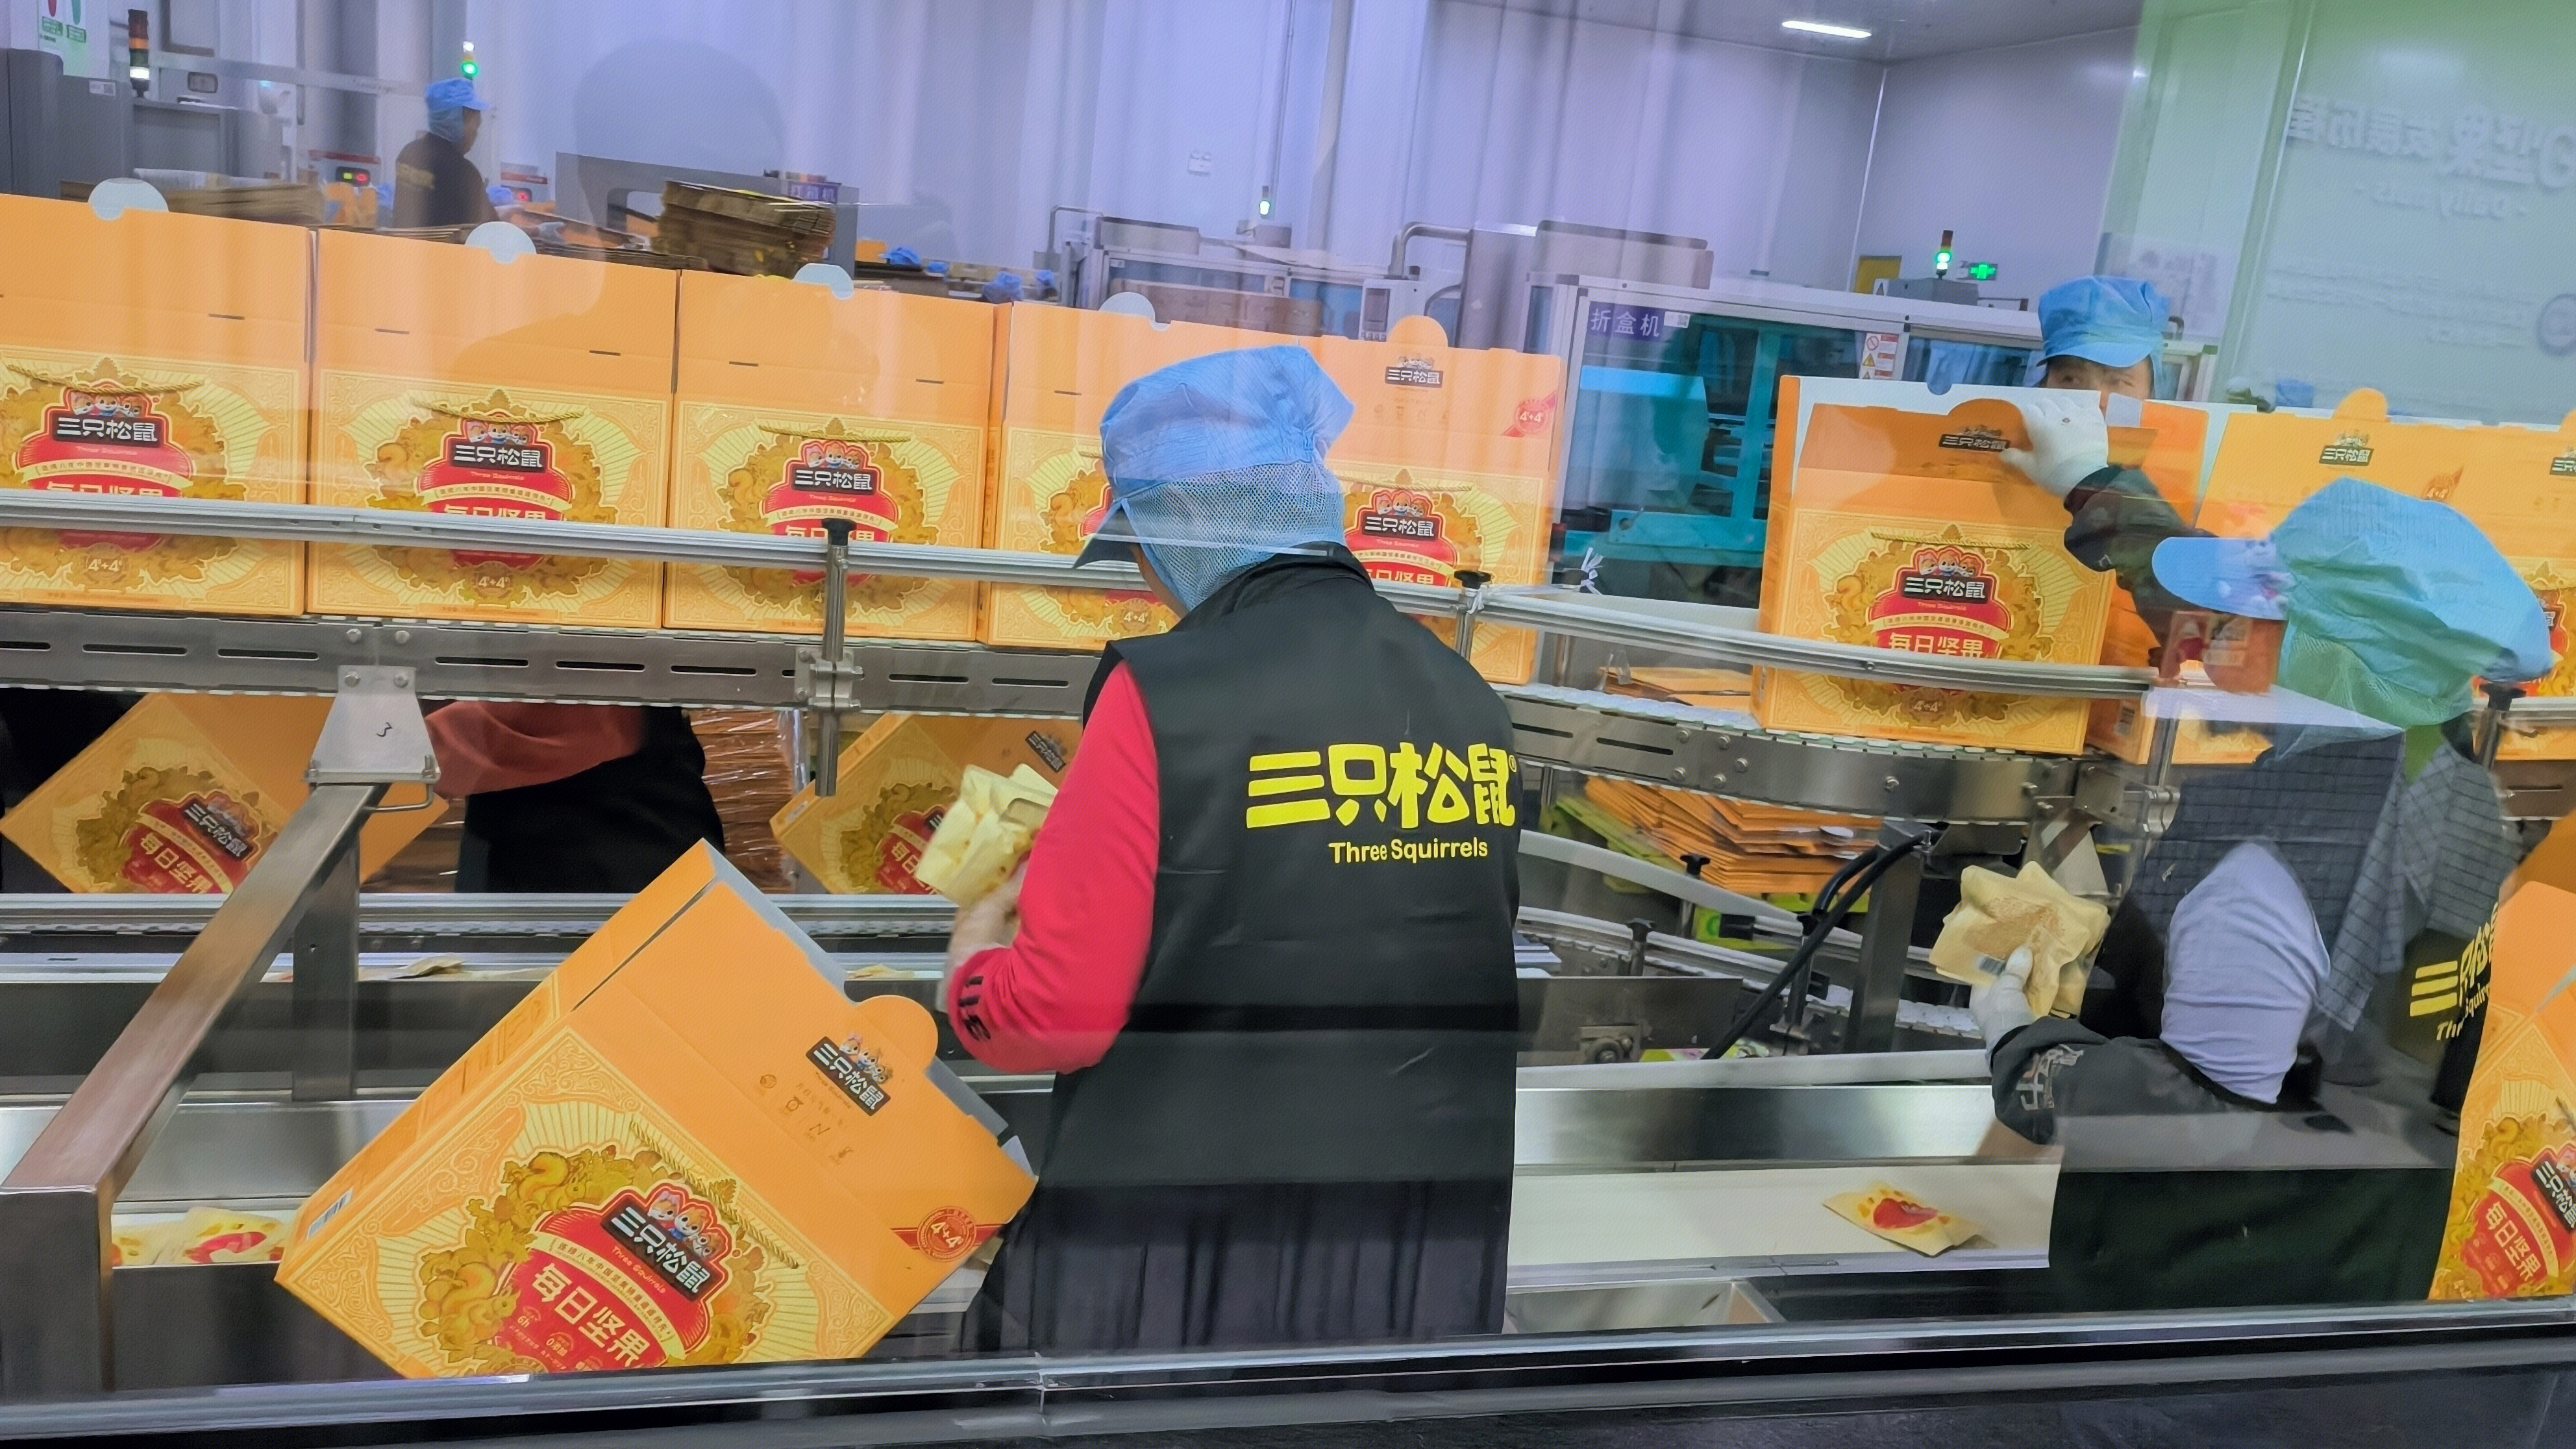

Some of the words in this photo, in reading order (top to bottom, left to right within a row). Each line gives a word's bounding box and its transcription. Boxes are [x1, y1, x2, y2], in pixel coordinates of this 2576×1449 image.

[1590, 308, 1660, 337] 折盒机
[1387, 369, 1441, 384] 三只松鼠
[57, 417, 158, 442] 三只松鼠
[454, 445, 543, 467] 三只松鼠
[2322, 448, 2371, 463] 三只松鼠
[795, 469, 873, 490] 三只松鼠
[1365, 516, 1434, 537] 三只松鼠
[1904, 576, 1985, 599] 三只松鼠
[1246, 741, 1516, 829] 三只松鼠
[183, 802, 251, 858] 三只松鼠
[139, 832, 213, 895] 每日坚果
[1328, 841, 1387, 864] Three
[1391, 836, 1489, 864] Squirrels
[813, 1042, 886, 1111] 三只松鼠
[610, 1206, 712, 1294] 三只松鼠
[2485, 1201, 2542, 1282] 每日坚果
[611, 1245, 632, 1267] Three
[632, 1263, 667, 1294] Squirrels
[531, 1263, 650, 1368] 每日坚果
